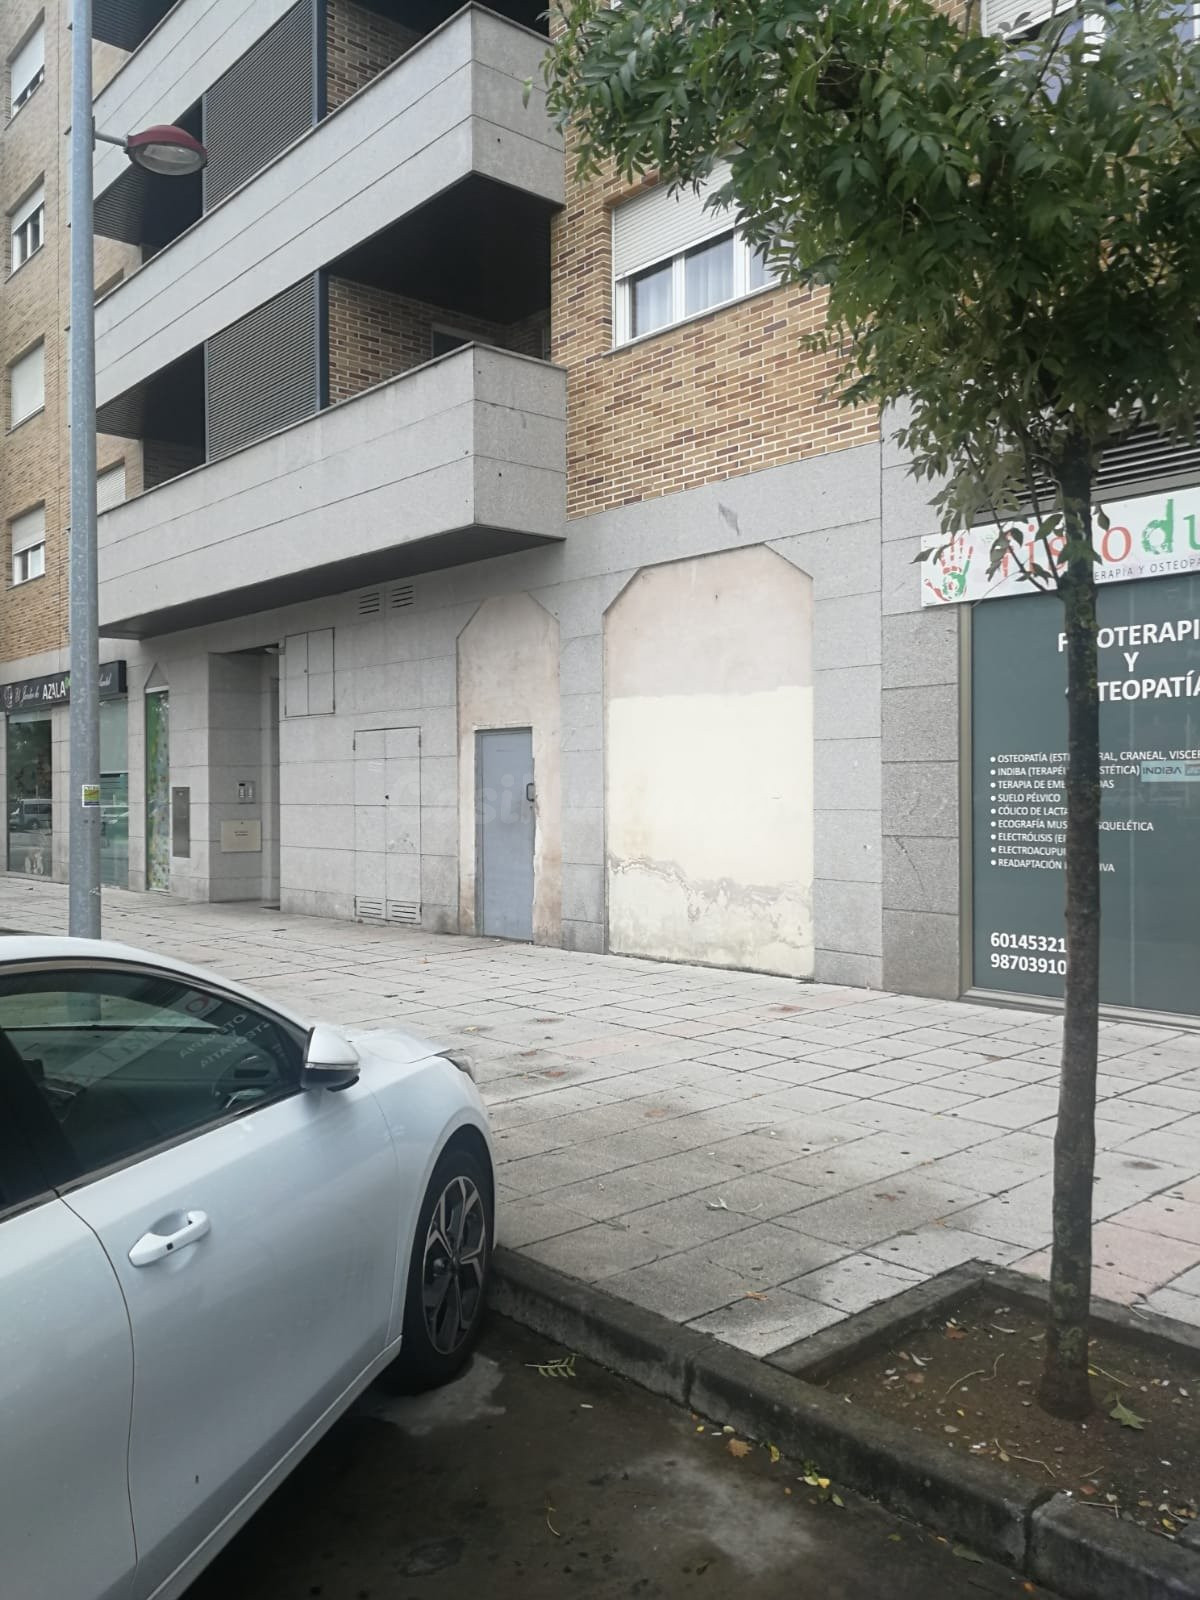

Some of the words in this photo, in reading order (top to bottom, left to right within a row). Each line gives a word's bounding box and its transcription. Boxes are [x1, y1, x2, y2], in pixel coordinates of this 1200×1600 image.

[1057, 619, 1200, 652] FOTERAPI
[1123, 651, 1140, 673] Y
[1064, 670, 1200, 702] TEOPATÍ
[997, 752, 1048, 763] OSTEOPATÍA
[1120, 751, 1167, 761] CRANEAL,
[997, 767, 1027, 776] INDIBA
[1099, 764, 1140, 776] STÉTICA)
[1142, 766, 1182, 775] INDIBA
[998, 780, 1032, 789] TERAPIA
[1034, 780, 1045, 789] DE
[997, 794, 1024, 802] SUELO
[1026, 792, 1061, 802] PÉLVICO
[998, 804, 1028, 815] CÓLICO
[1030, 807, 1041, 815] DE
[998, 819, 1045, 828] ECOGRAFÍA
[998, 832, 1053, 842] ELECTRÓLISIS
[998, 846, 1066, 855] ELECTROACUPU
[998, 859, 1062, 869] READAPTACIÓN
[991, 932, 1067, 953] 60145321
[990, 953, 1067, 975] 98703910
